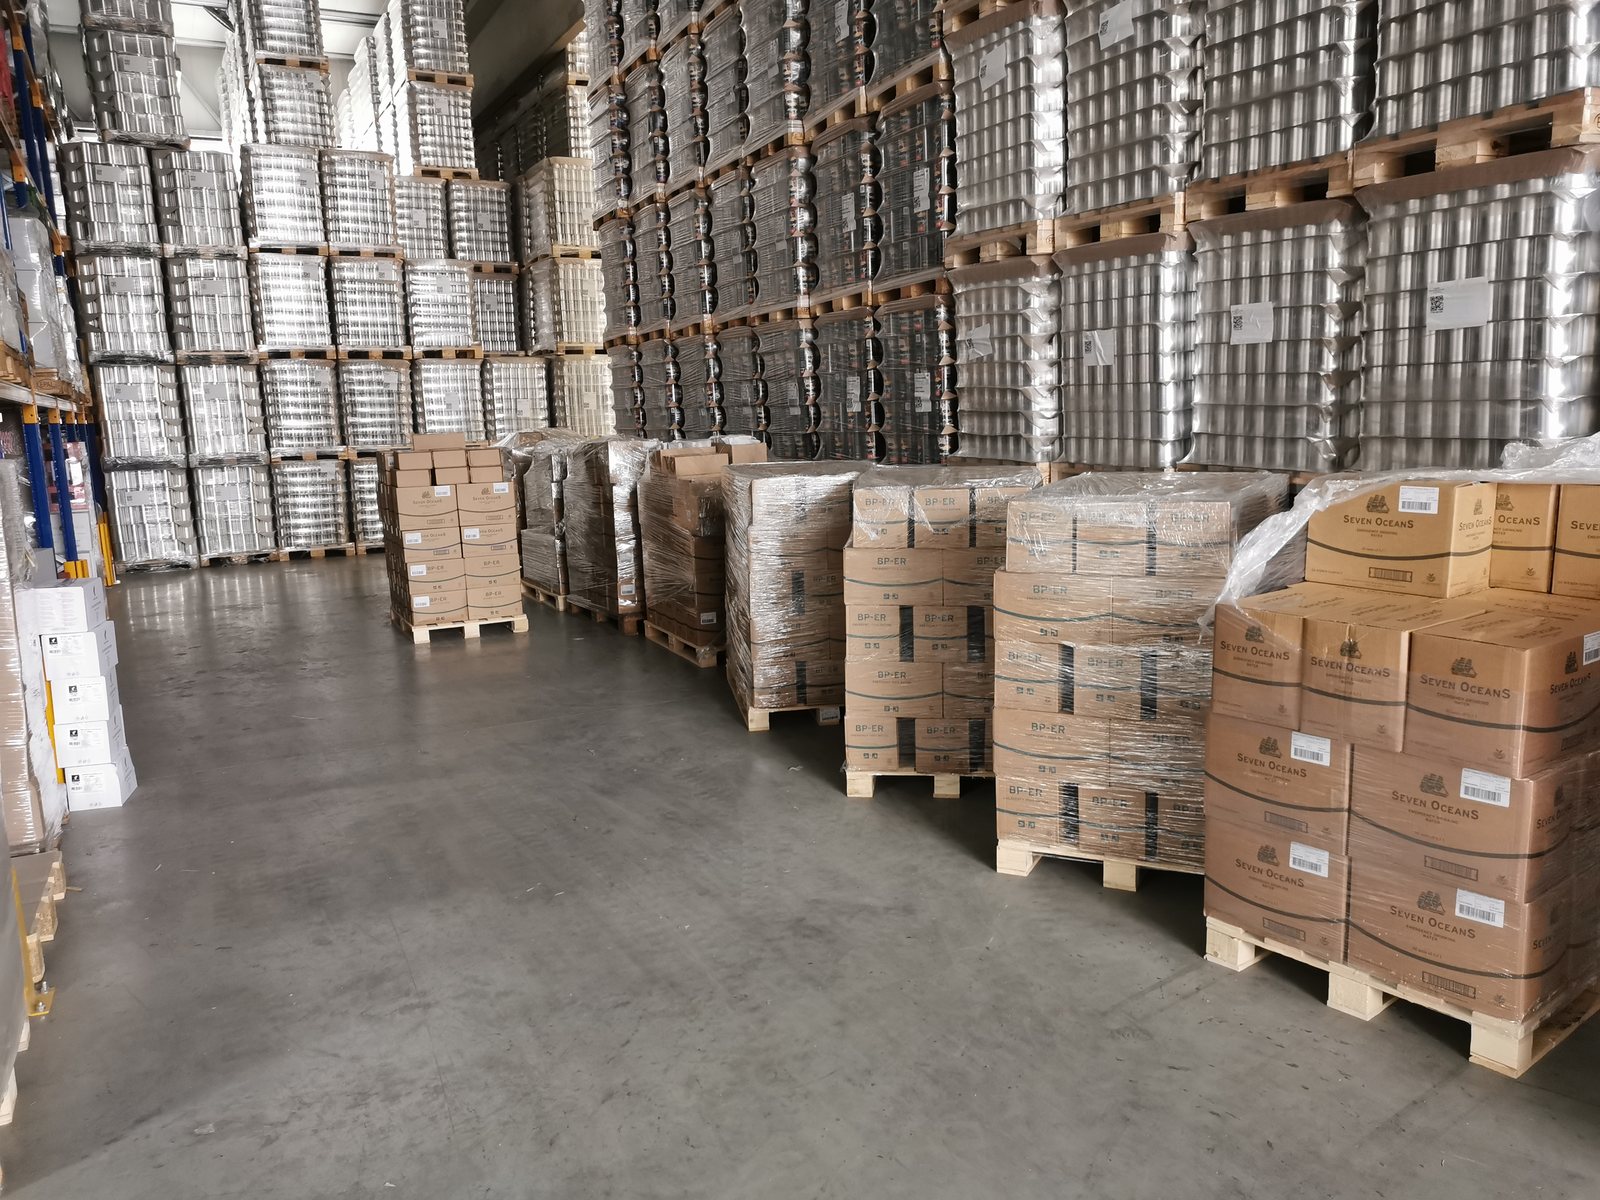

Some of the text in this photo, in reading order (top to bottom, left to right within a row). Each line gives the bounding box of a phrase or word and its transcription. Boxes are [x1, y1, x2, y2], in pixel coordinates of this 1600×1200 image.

[925, 497, 955, 506] BP-ER
[1343, 514, 1414, 529] SEVEN OCEANS
[1459, 516, 1492, 531] SEVEN OCEANS
[1498, 514, 1540, 526] OCEANS
[1570, 520, 1600, 531] SEVE
[877, 557, 907, 565] BP-ER
[1032, 584, 1068, 594] BP-ER
[857, 613, 887, 621] BP-ER
[924, 614, 954, 622] BP-ER
[1220, 640, 1290, 661] SEVEN OCEANS
[1310, 656, 1391, 678] SEVEN OCEANS
[877, 671, 907, 679] BP-ER
[1420, 674, 1511, 700] SEVEN OCEANS
[1550, 680, 1569, 695] SEVEN
[855, 725, 884, 733] BP-ER
[927, 727, 956, 735] BP-ER
[1031, 722, 1066, 734] BP-ER
[1237, 752, 1265, 768] SEVEN
[1268, 760, 1307, 778] OCEANS
[1009, 786, 1043, 797] BP-ER
[1391, 790, 1480, 821] SEVEN OCEANS
[1235, 858, 1263, 875] SEVEN
[1266, 868, 1304, 888] OCEANS
[1390, 905, 1476, 940] SEVEN OCEANS
